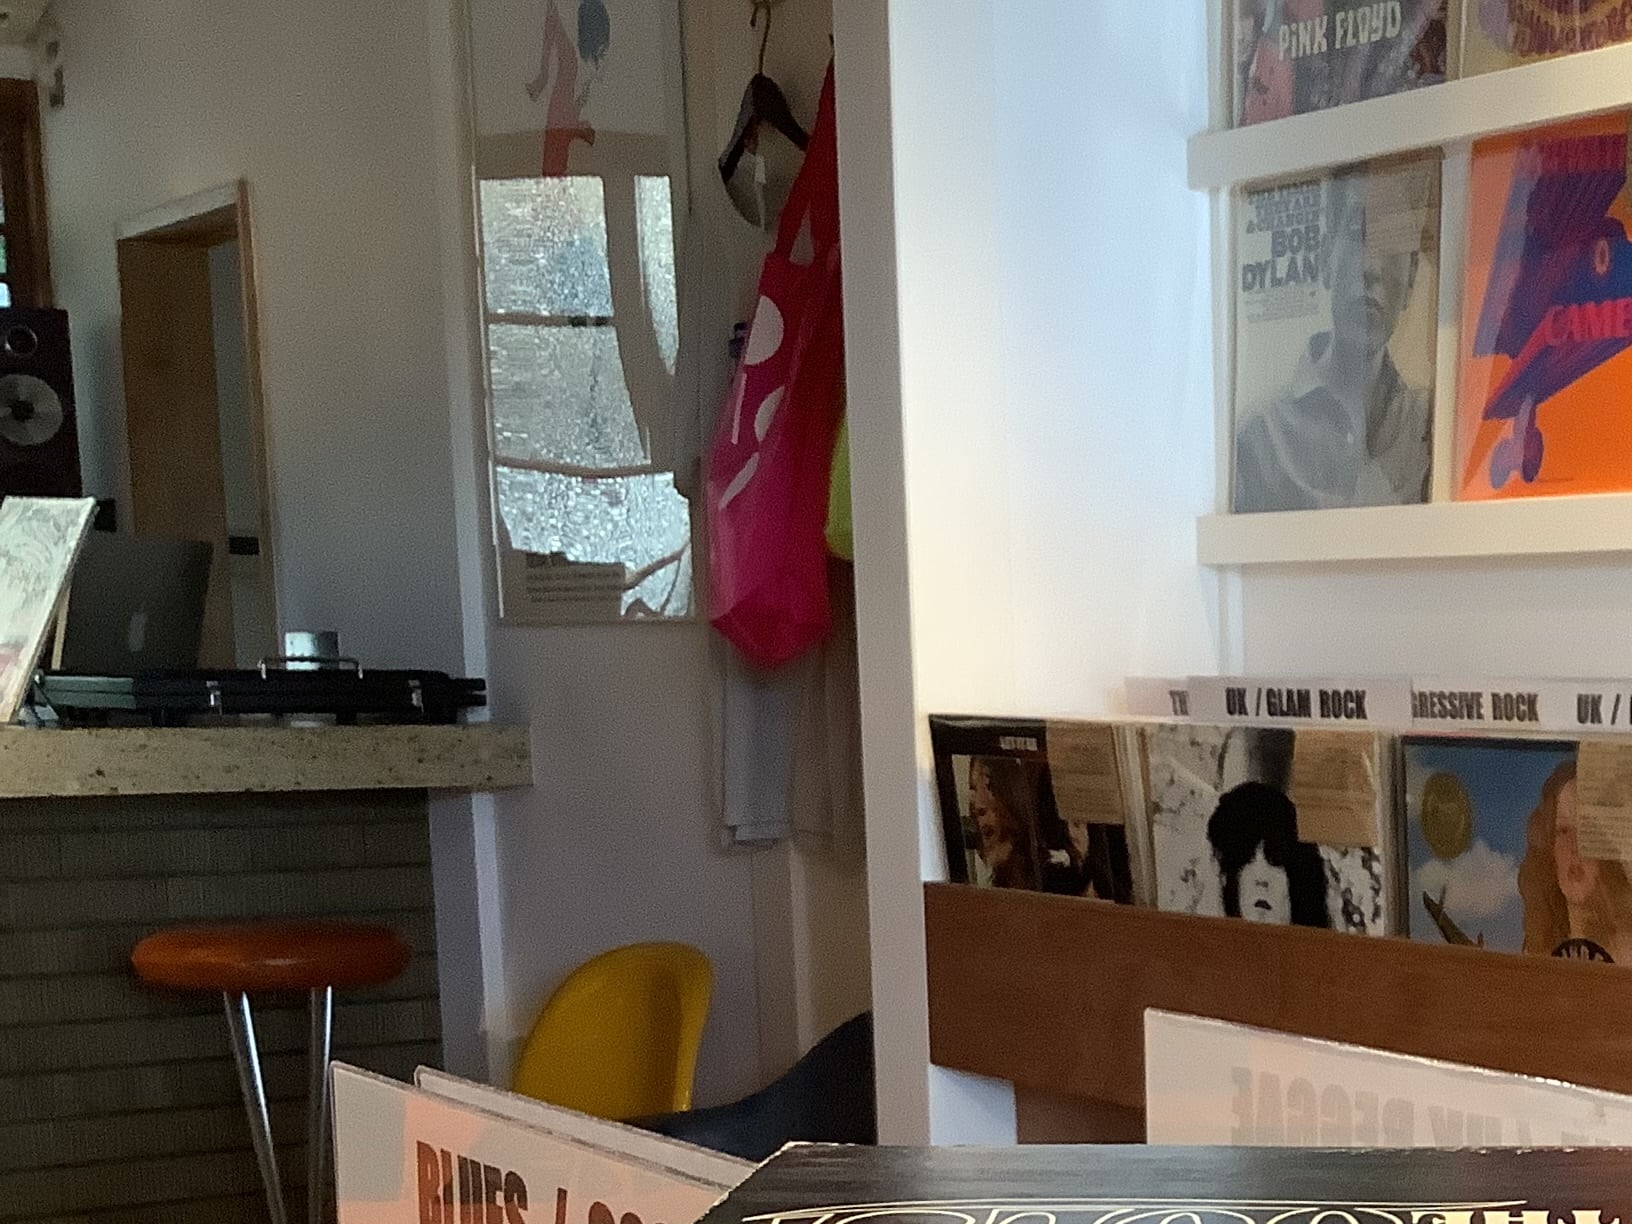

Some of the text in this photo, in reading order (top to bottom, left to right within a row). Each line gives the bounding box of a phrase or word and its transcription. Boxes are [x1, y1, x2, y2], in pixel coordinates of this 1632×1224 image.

[1335, 1, 1402, 49] FLOYD
[1271, 224, 1321, 258] BOB
[1241, 256, 1320, 293] DYLAN
[1226, 687, 1250, 716] UK
[1266, 688, 1312, 718] GLAM
[1318, 690, 1368, 720] ROCK
[1490, 692, 1540, 722] ROCK
[1576, 693, 1603, 725] UK
